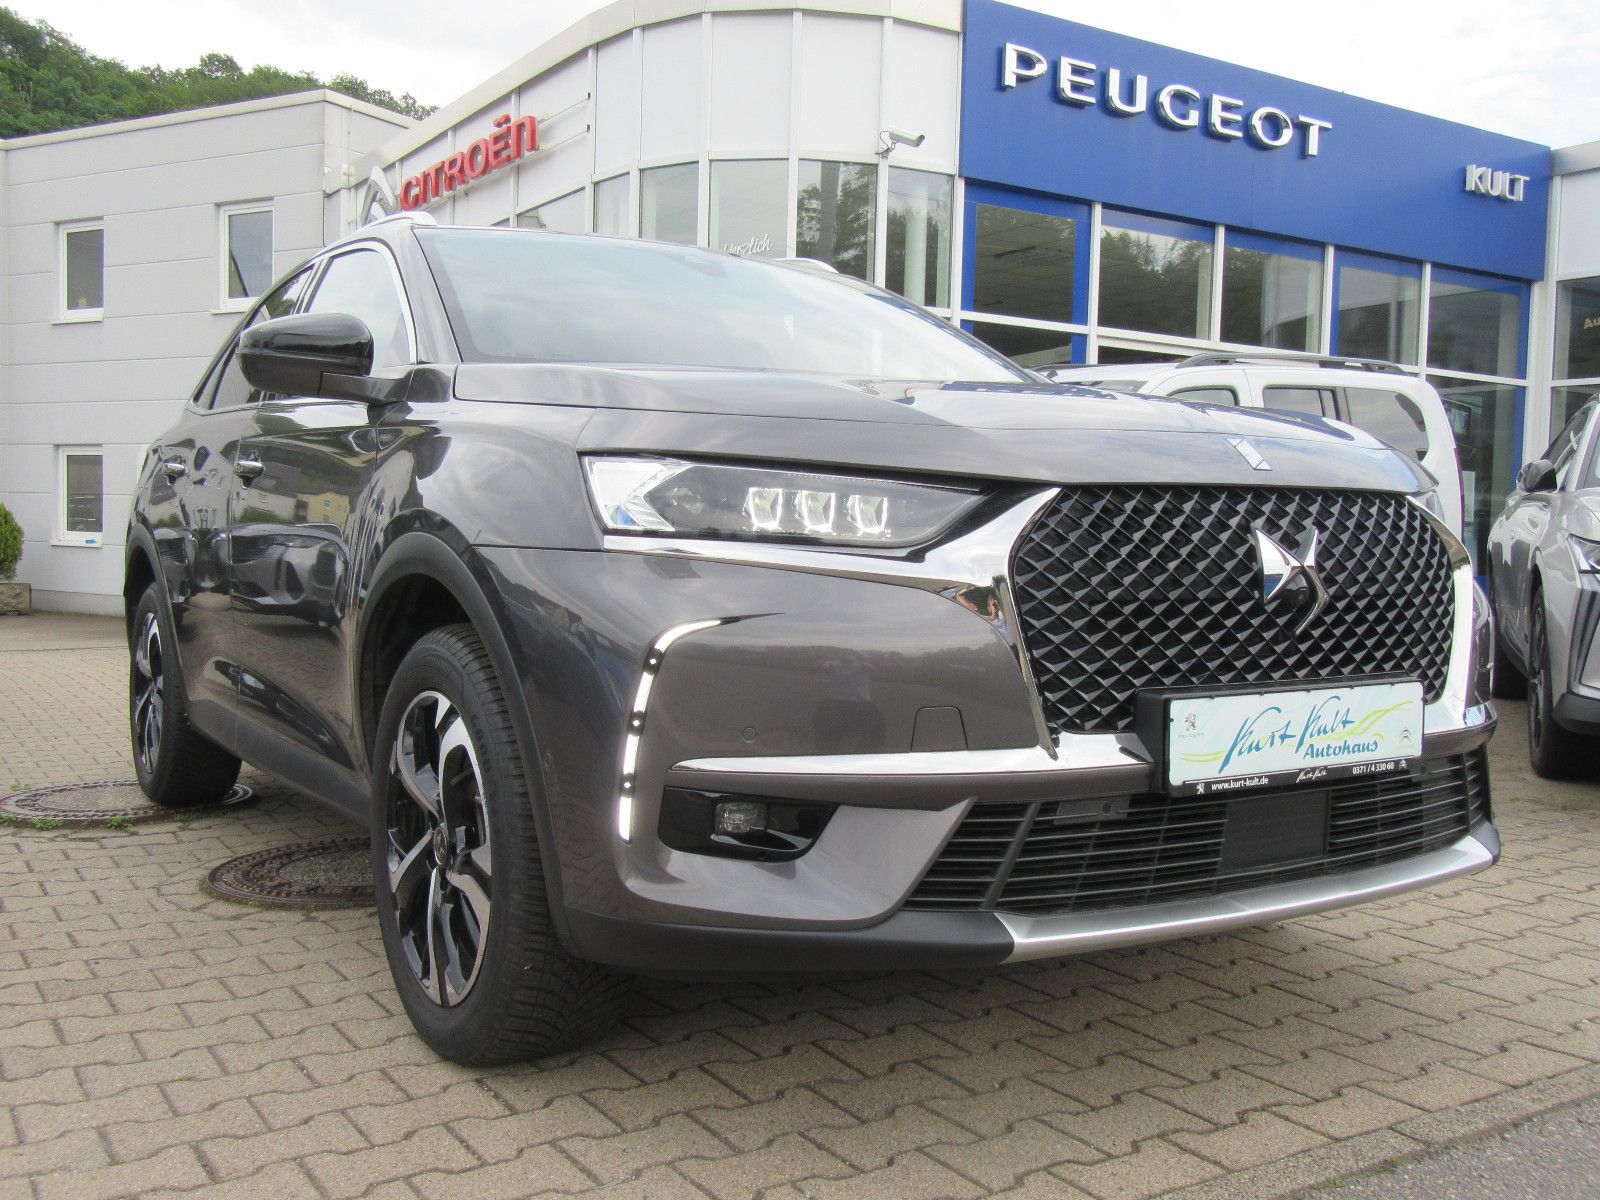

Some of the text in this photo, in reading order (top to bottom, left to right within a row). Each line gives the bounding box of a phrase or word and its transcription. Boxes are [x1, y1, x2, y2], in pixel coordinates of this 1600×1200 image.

[1001, 42, 1332, 157] PEUGEOT
[1465, 164, 1530, 201] KULT
[1218, 695, 1355, 774] Kurt Kult
[1303, 739, 1378, 760] Autohaus
[1211, 776, 1269, 791] www.kurt-kult.de
